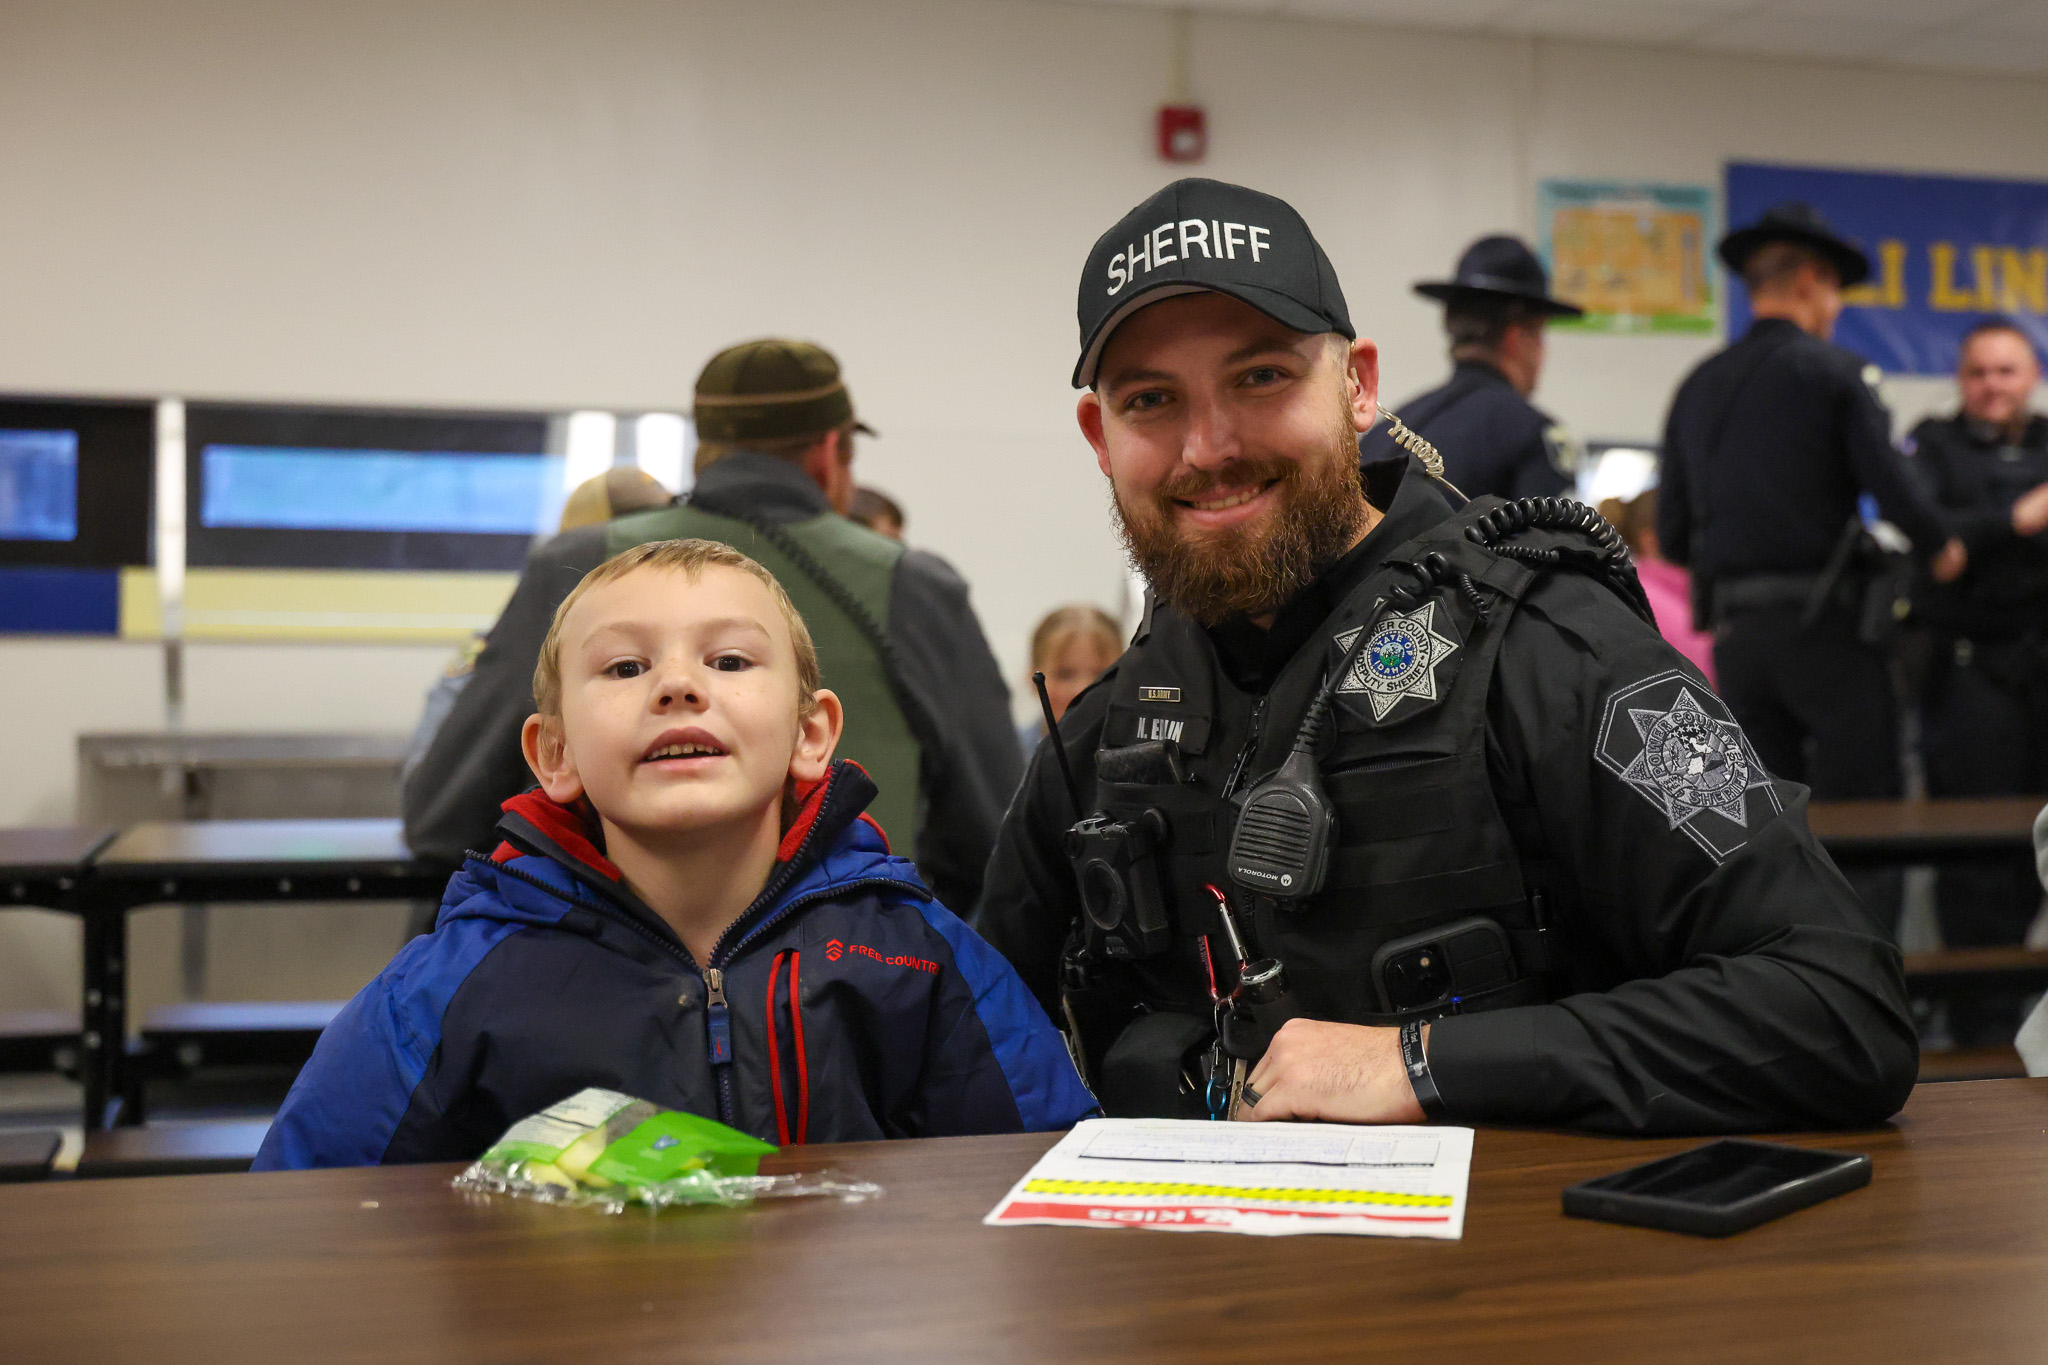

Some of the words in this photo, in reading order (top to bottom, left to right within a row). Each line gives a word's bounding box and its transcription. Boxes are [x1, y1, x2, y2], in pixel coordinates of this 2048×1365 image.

[1106, 218, 1271, 296] SHERIFF
[1373, 634, 1402, 653] STATE
[1398, 620, 1429, 655] COUNTY
[1357, 656, 1385, 690] DEPUTY
[1387, 661, 1426, 691] SHERIFF
[1374, 660, 1407, 674] IDAHO
[1646, 721, 1674, 777] POWER
[1672, 711, 1737, 753] COUNTY
[1689, 770, 1748, 806] SHERIFF
[1238, 867, 1278, 881] MOTOROLA
[849, 944, 883, 962] FREE
[1088, 1208, 1187, 1224] KIDS
